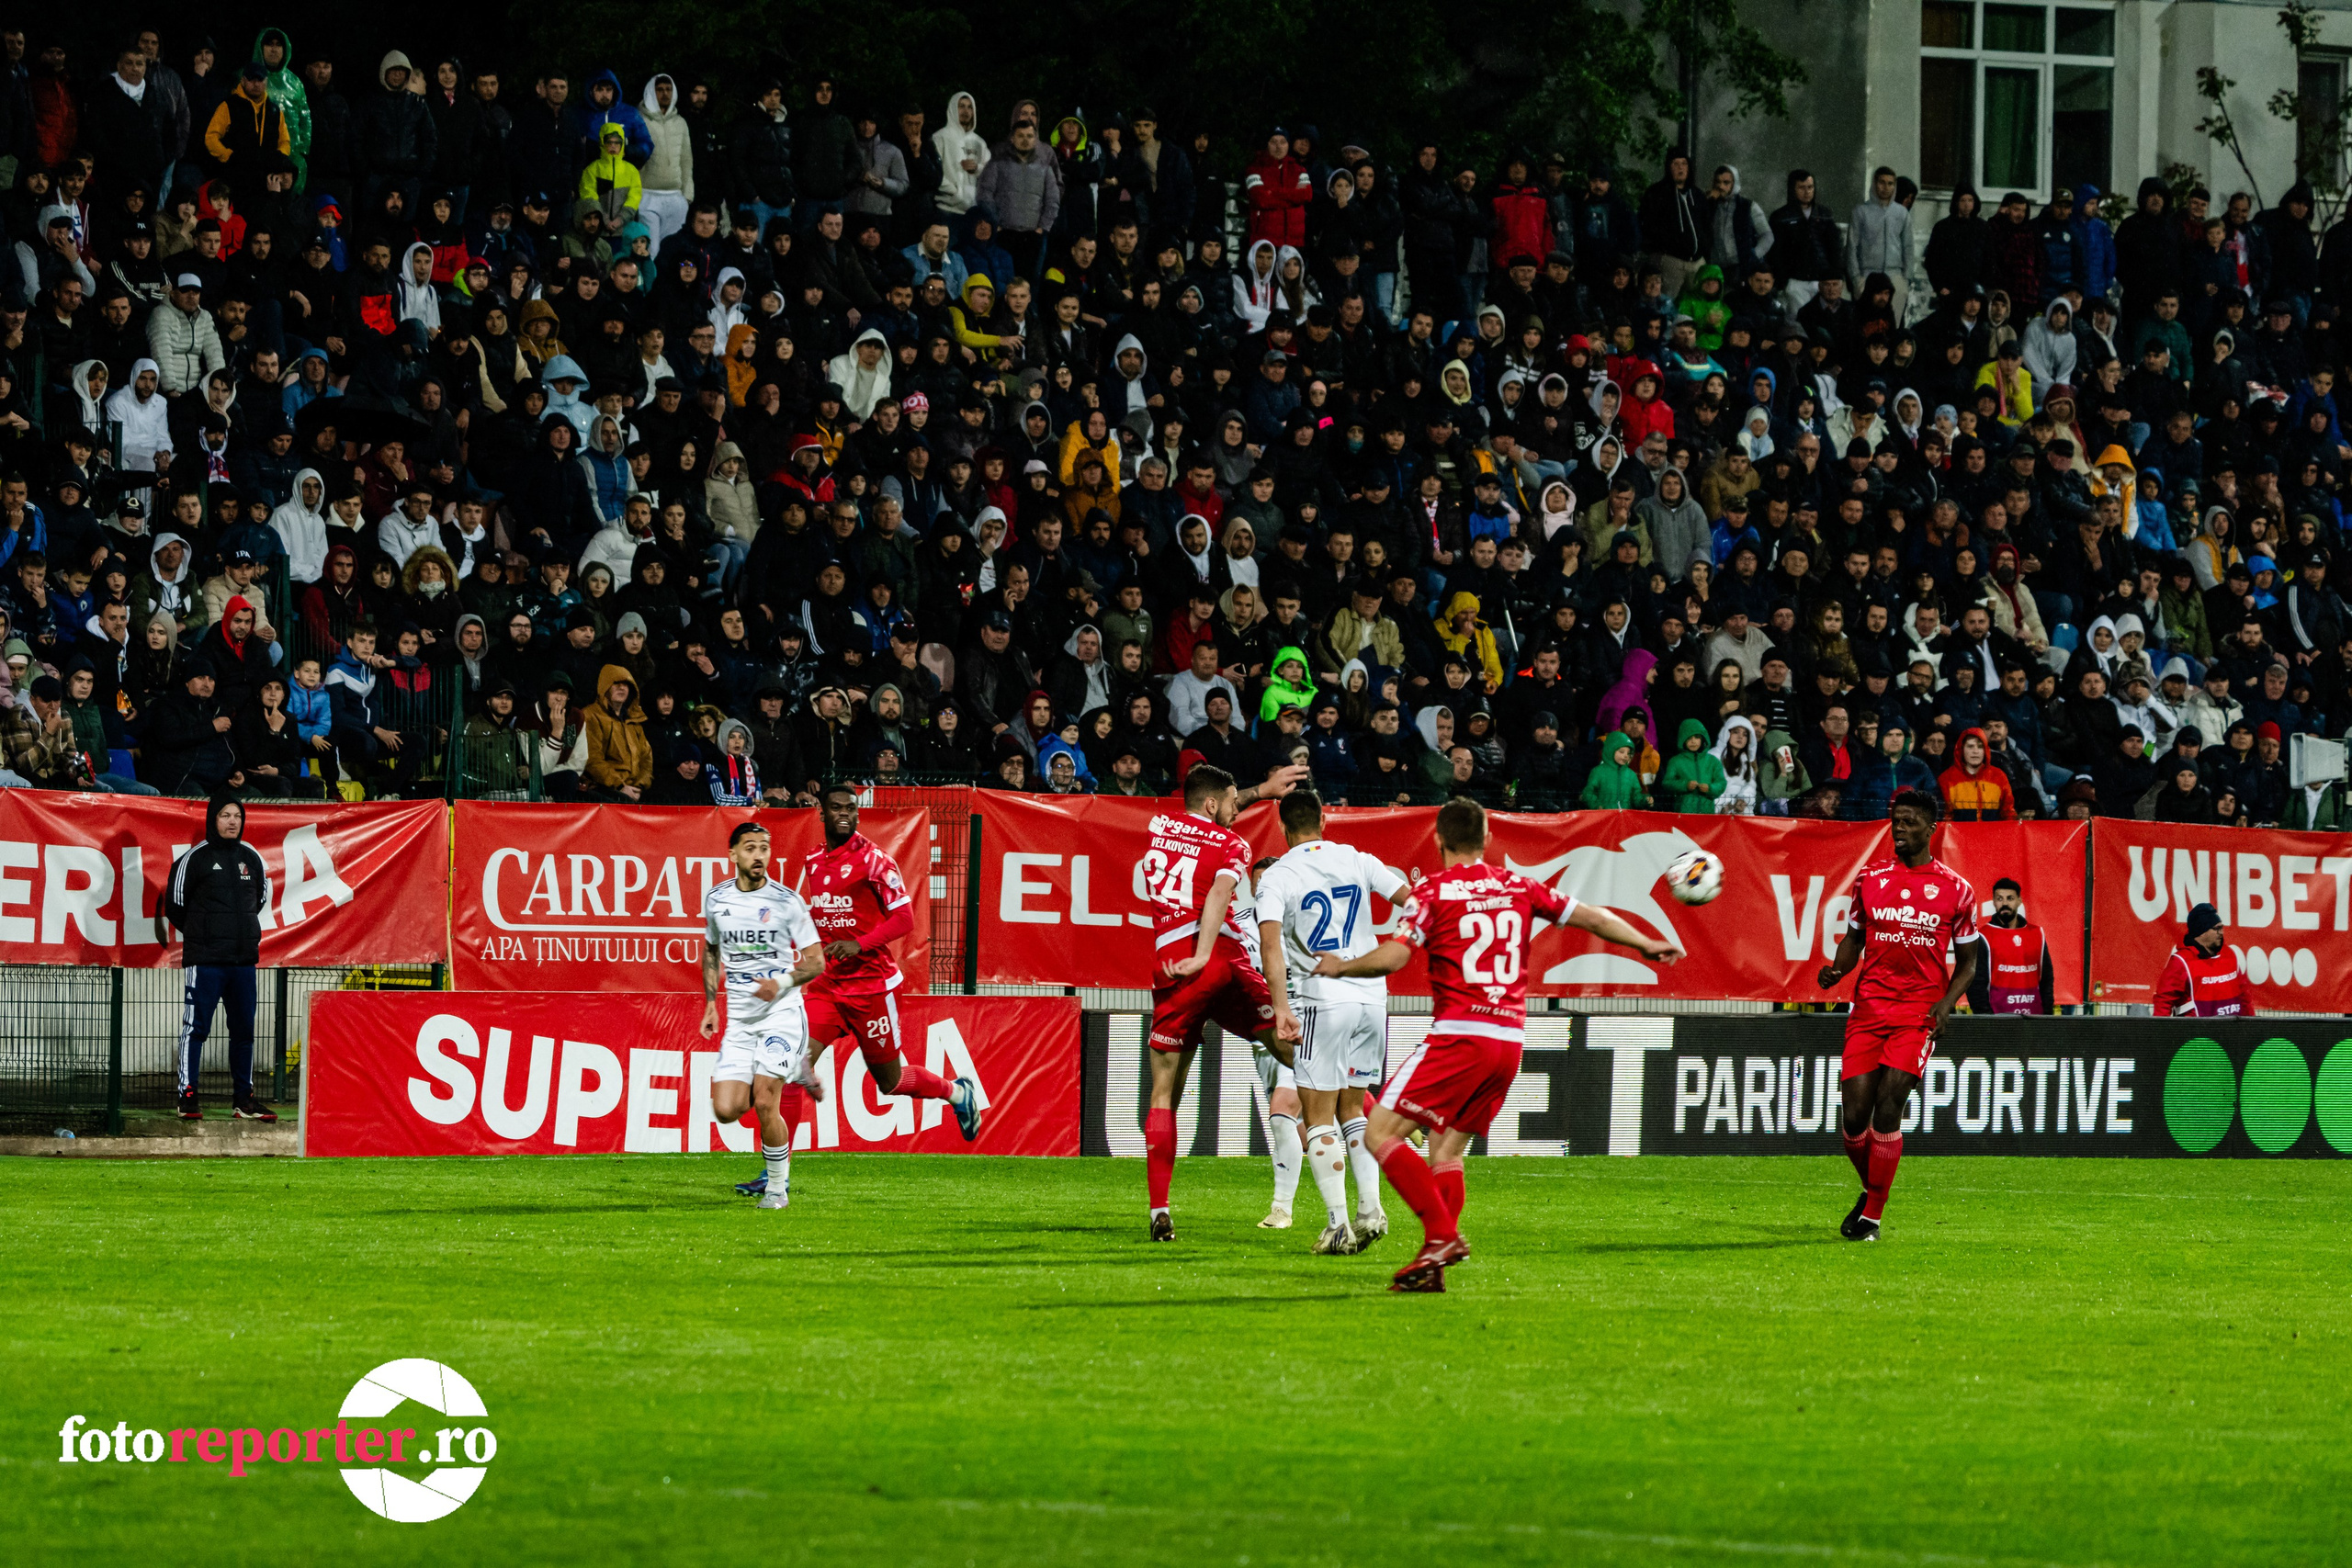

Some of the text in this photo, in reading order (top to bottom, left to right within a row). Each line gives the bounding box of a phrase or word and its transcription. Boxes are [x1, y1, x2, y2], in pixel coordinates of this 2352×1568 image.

[1150, 836, 1201, 857] VELKOVSKI
[0, 823, 354, 947] ERLA
[482, 847, 813, 931] CARPAT
[1143, 849, 1199, 910] 24
[1301, 884, 1362, 953] 27
[1458, 909, 1523, 985] 23
[1871, 905, 1940, 928] WIN2.RO
[481, 936, 700, 966] APA ȚINUTULUI CU
[866, 1016, 890, 1039] 28
[2007, 994, 2036, 1004] STAFF
[1674, 1056, 1843, 1134] PARIU
